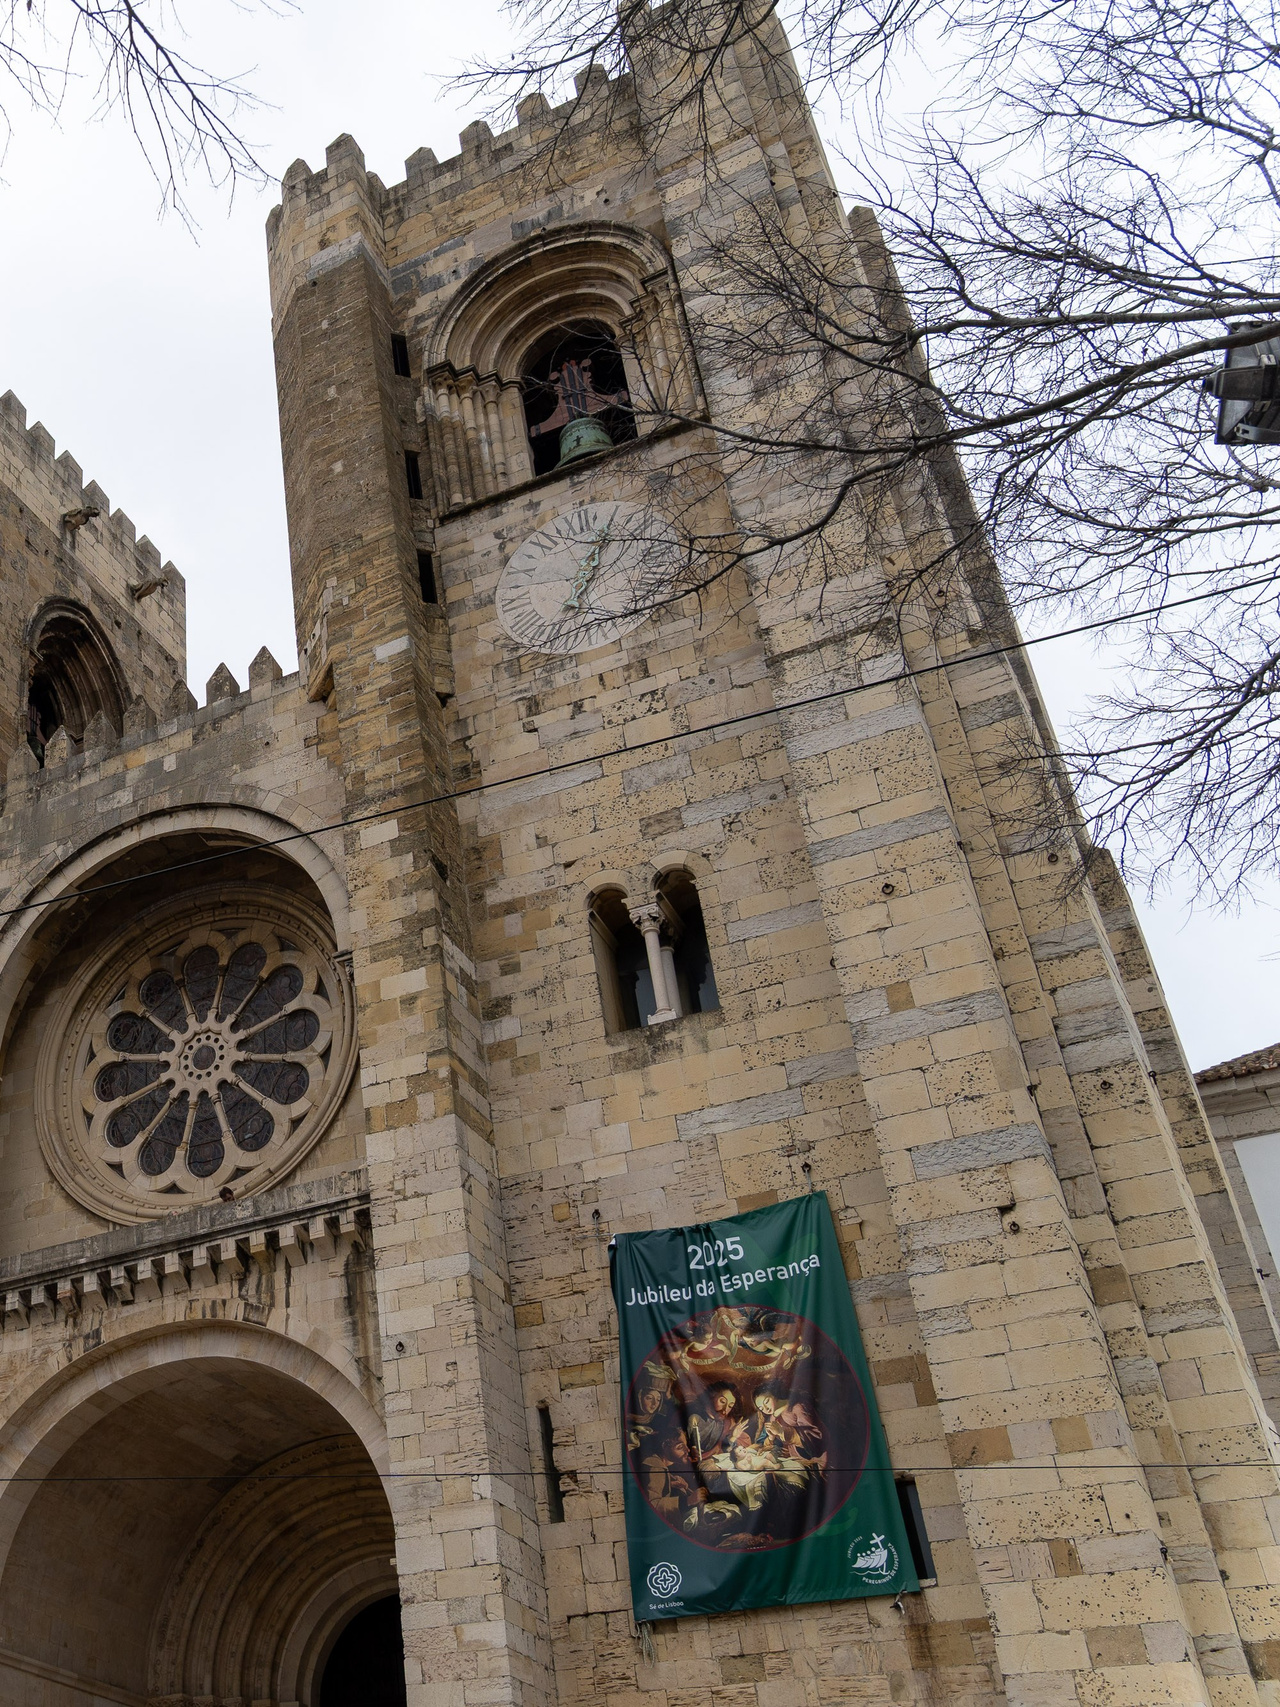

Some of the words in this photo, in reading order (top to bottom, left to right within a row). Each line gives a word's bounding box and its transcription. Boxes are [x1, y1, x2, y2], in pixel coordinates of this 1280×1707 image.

[562, 508, 591, 537] XII
[529, 530, 559, 557] XI
[507, 565, 537, 578] X
[501, 589, 532, 613] IX
[687, 1236, 744, 1270] 2025
[625, 1286, 692, 1306] Jubileu
[696, 1279, 715, 1297] da
[721, 1253, 820, 1293] Esperança
